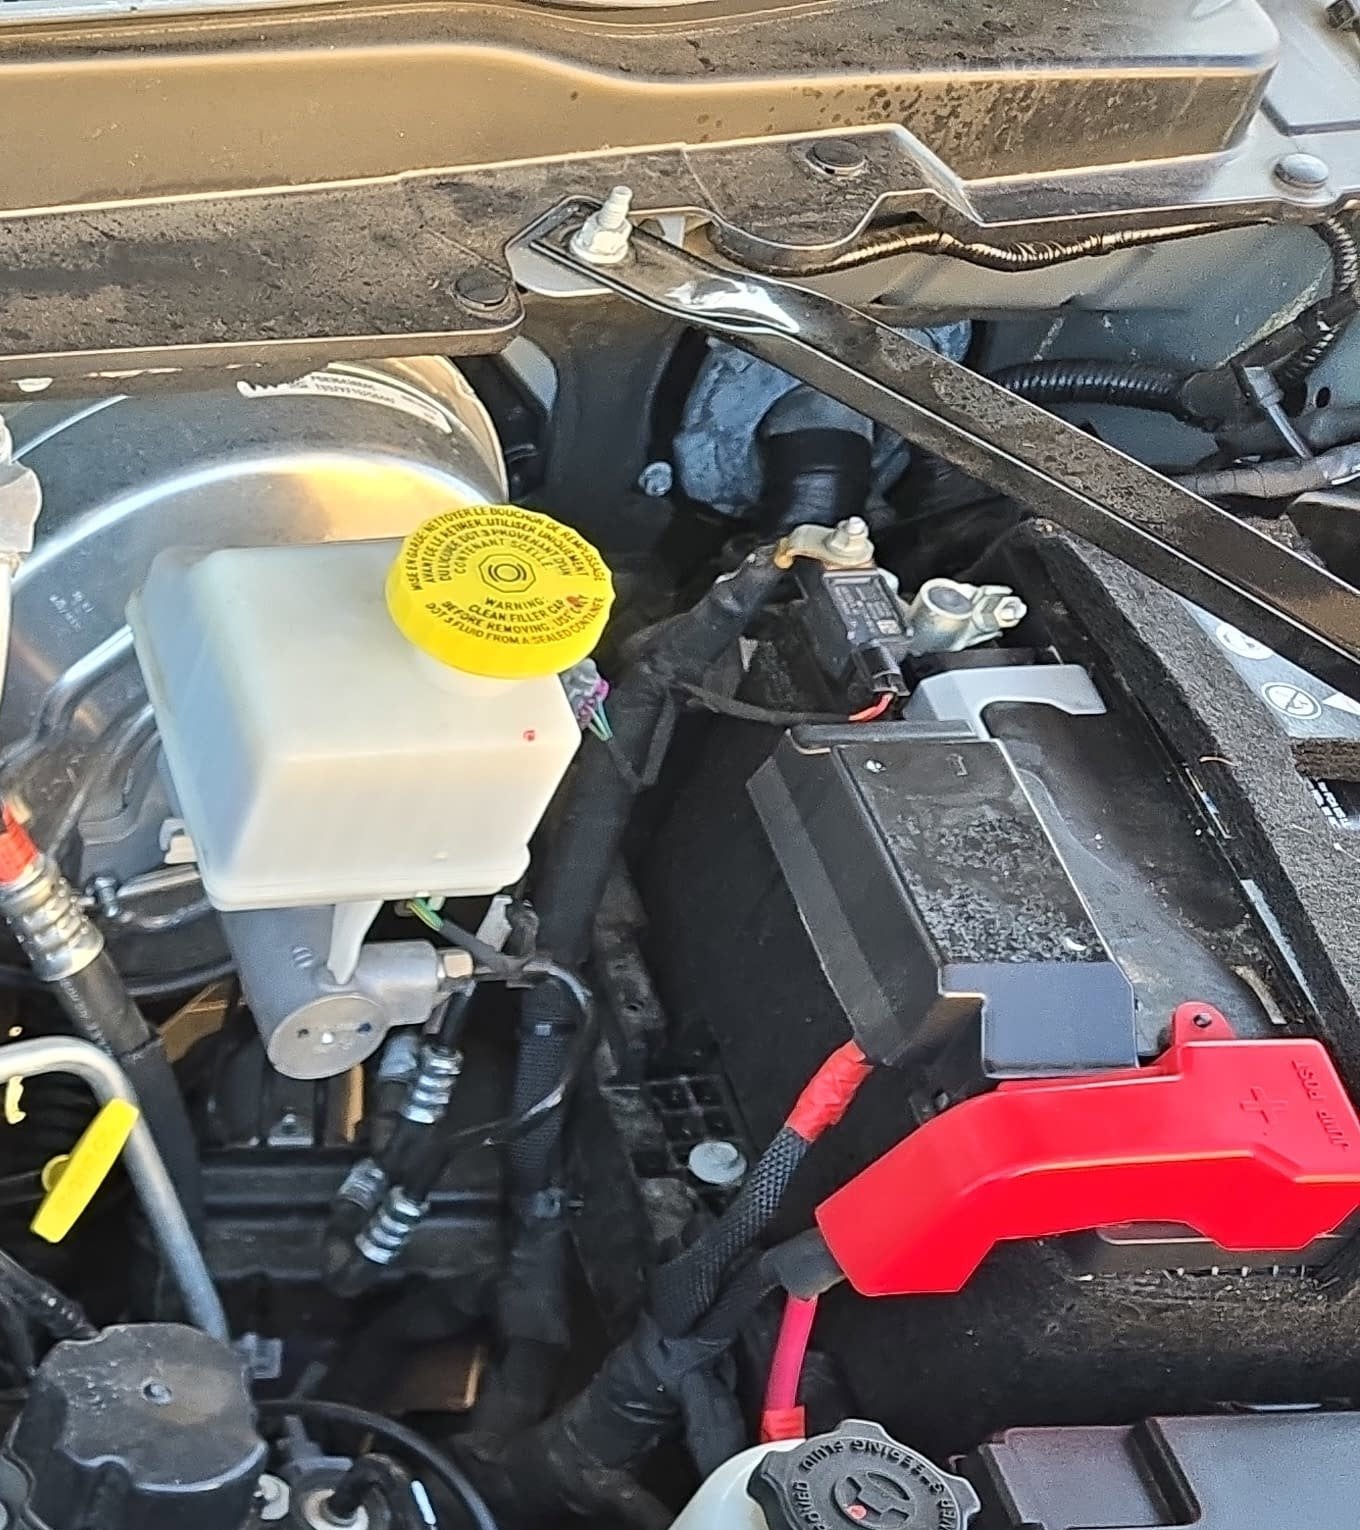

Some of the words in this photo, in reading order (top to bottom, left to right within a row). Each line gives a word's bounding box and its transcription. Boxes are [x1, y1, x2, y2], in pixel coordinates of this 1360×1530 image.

[423, 508, 472, 534] NETTOYER
[473, 506, 487, 516] LE
[489, 507, 545, 527] BOUCHON
[545, 521, 561, 533] DE
[560, 530, 608, 582] REMPLISSAGE
[429, 535, 445, 549] LE
[486, 517, 537, 534] UTILISER
[537, 529, 590, 577] UNIQUEMENT
[453, 537, 505, 575] CONTENANT
[492, 528, 558, 557] PROVENANT
[424, 602, 443, 619] DOT
[443, 616, 454, 625] 3
[452, 619, 485, 638] FLUID
[485, 632, 521, 645] FROM
[521, 637, 530, 645] A
[530, 629, 573, 645] SEALED
[441, 600, 483, 627] BEFORE
[555, 609, 572, 628] USE
[468, 603, 507, 622] CLEAN
[509, 609, 547, 623] FILLER
[547, 599, 565, 615] CAP
[1290, 1059, 1327, 1102] POST
[797, 1440, 845, 1474] FLUID
[849, 1439, 946, 1496] STEERING
